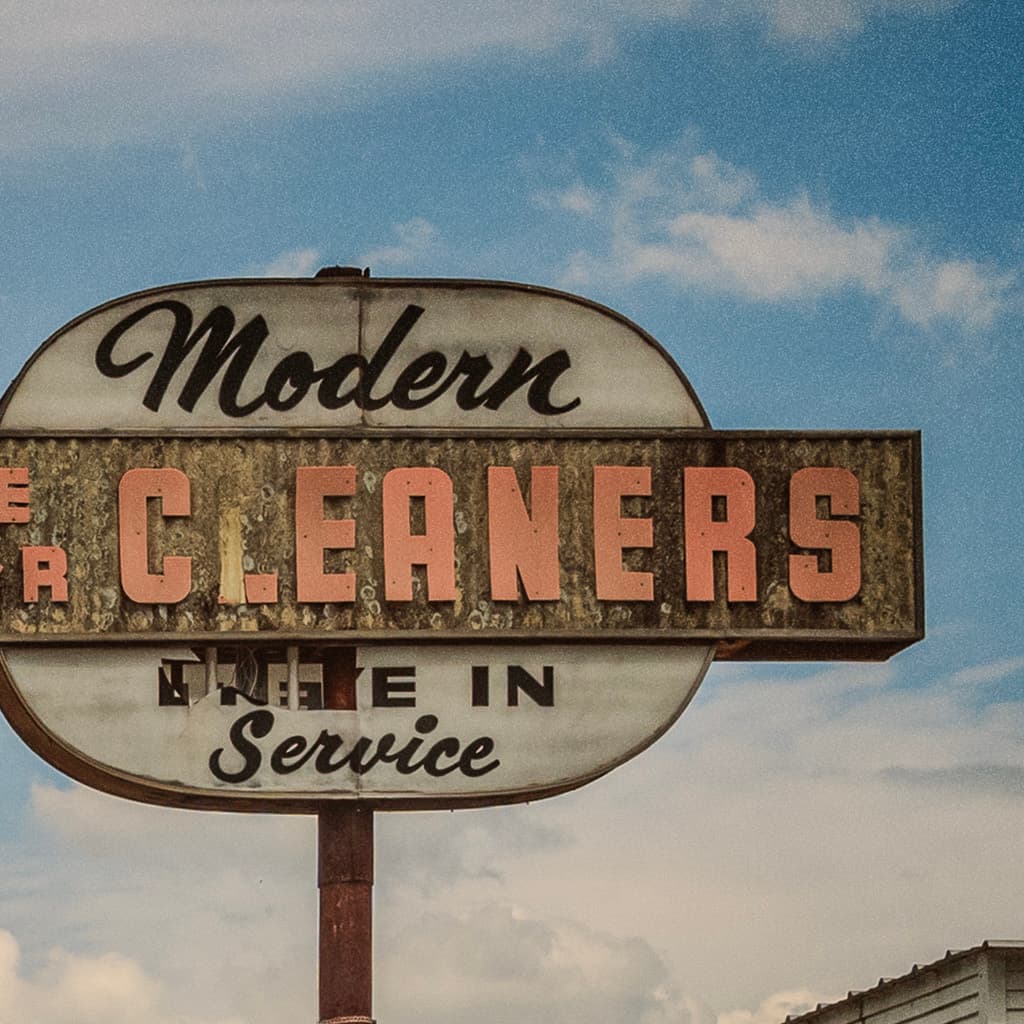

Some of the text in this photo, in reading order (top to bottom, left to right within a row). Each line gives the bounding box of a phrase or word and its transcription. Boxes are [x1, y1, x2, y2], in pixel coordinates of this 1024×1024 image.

[95, 300, 581, 417] Modern
[471, 665, 555, 707] IN
[209, 709, 500, 784] Service
